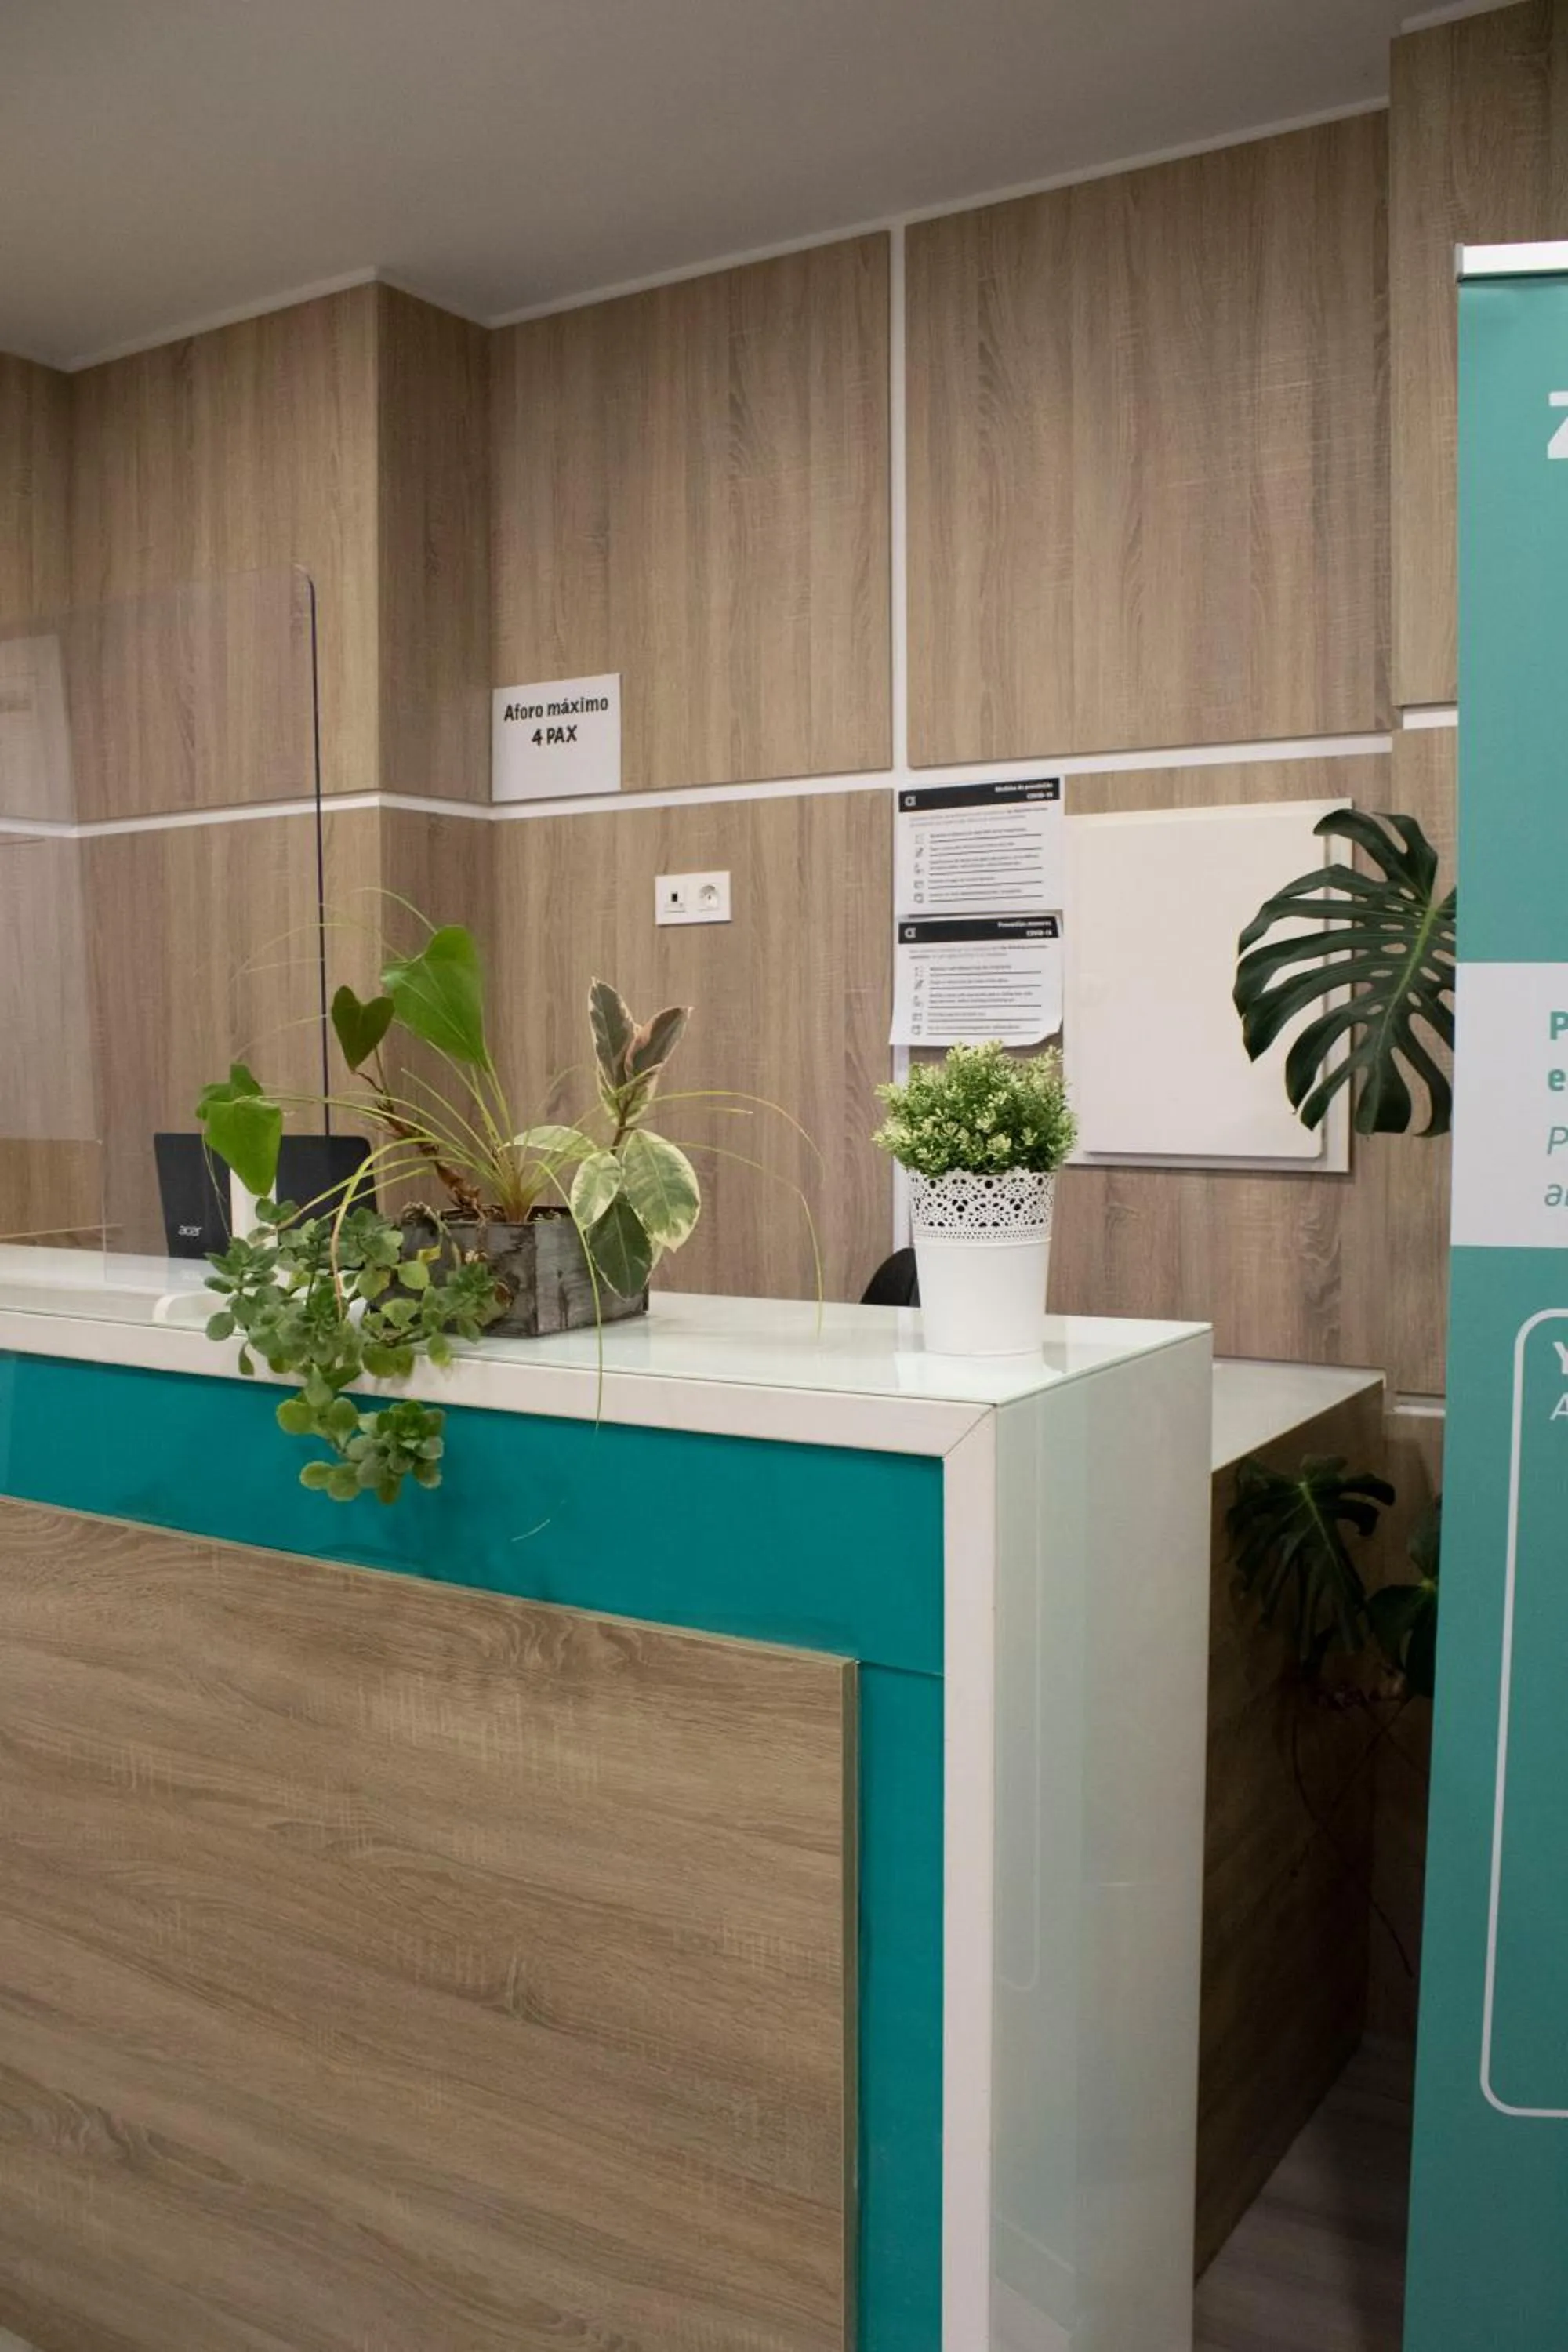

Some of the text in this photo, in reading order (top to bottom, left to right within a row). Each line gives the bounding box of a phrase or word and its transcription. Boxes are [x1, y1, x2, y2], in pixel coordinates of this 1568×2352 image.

[504, 697, 608, 722] Aforo máximo
[532, 724, 578, 746] 4 PAX
